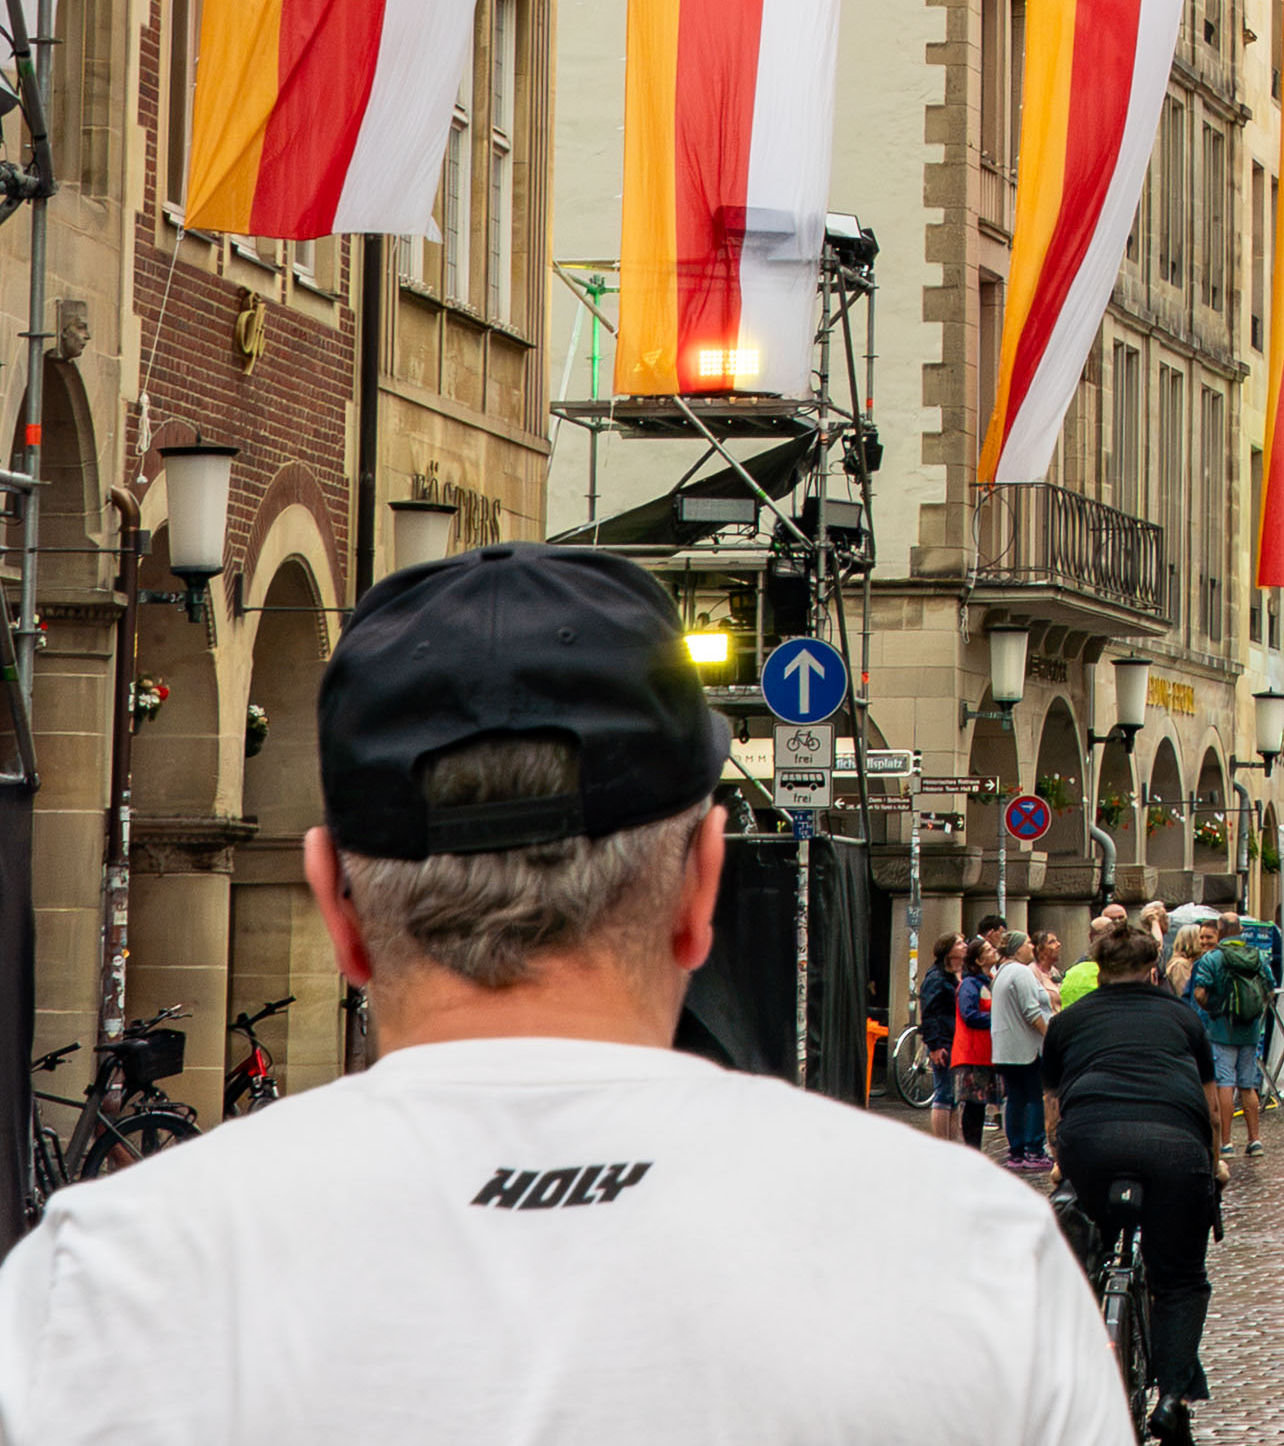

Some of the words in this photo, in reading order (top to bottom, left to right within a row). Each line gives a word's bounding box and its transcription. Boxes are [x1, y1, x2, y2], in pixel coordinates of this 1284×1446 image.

[794, 753, 813, 764] frei
[793, 793, 812, 804] frei
[468, 1160, 654, 1211] HOLY
